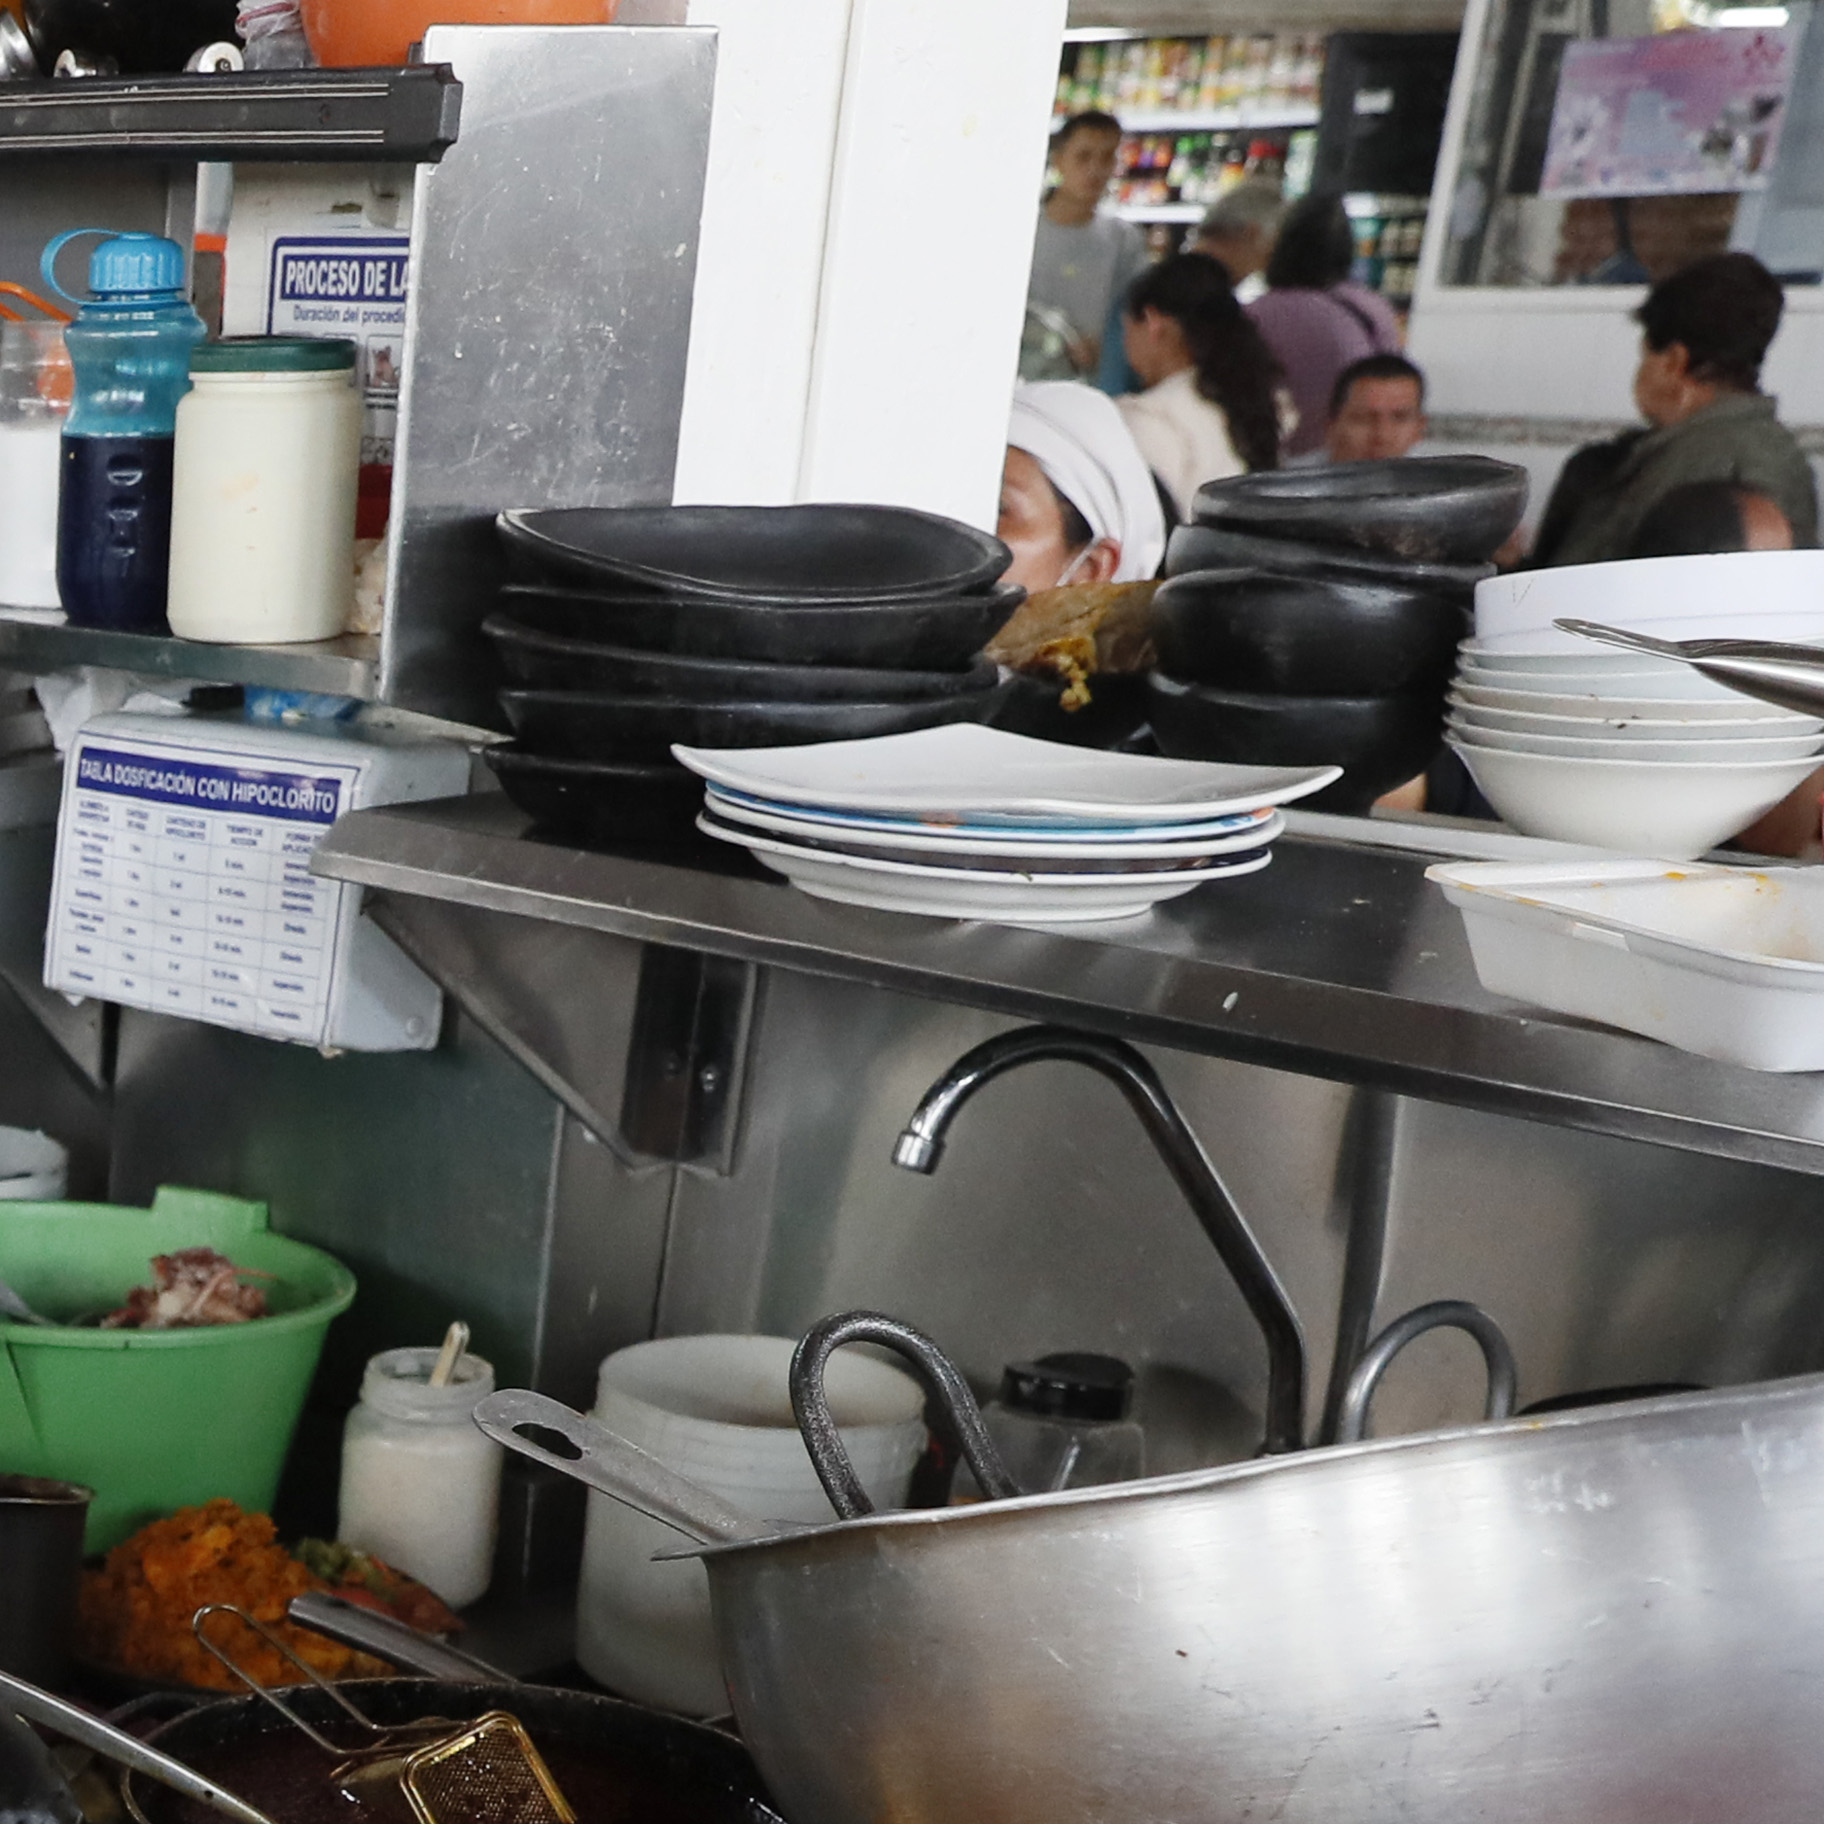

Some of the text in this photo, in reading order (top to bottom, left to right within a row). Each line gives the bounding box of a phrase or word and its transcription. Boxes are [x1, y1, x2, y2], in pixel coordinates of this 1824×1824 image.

[285, 260, 360, 297] PROCESO
[363, 260, 387, 297] DE
[294, 304, 340, 322] Duración
[342, 306, 359, 323] del
[80, 757, 113, 783] TABLA
[197, 777, 230, 801] CON
[231, 780, 336, 814] HIPOCLORITO
